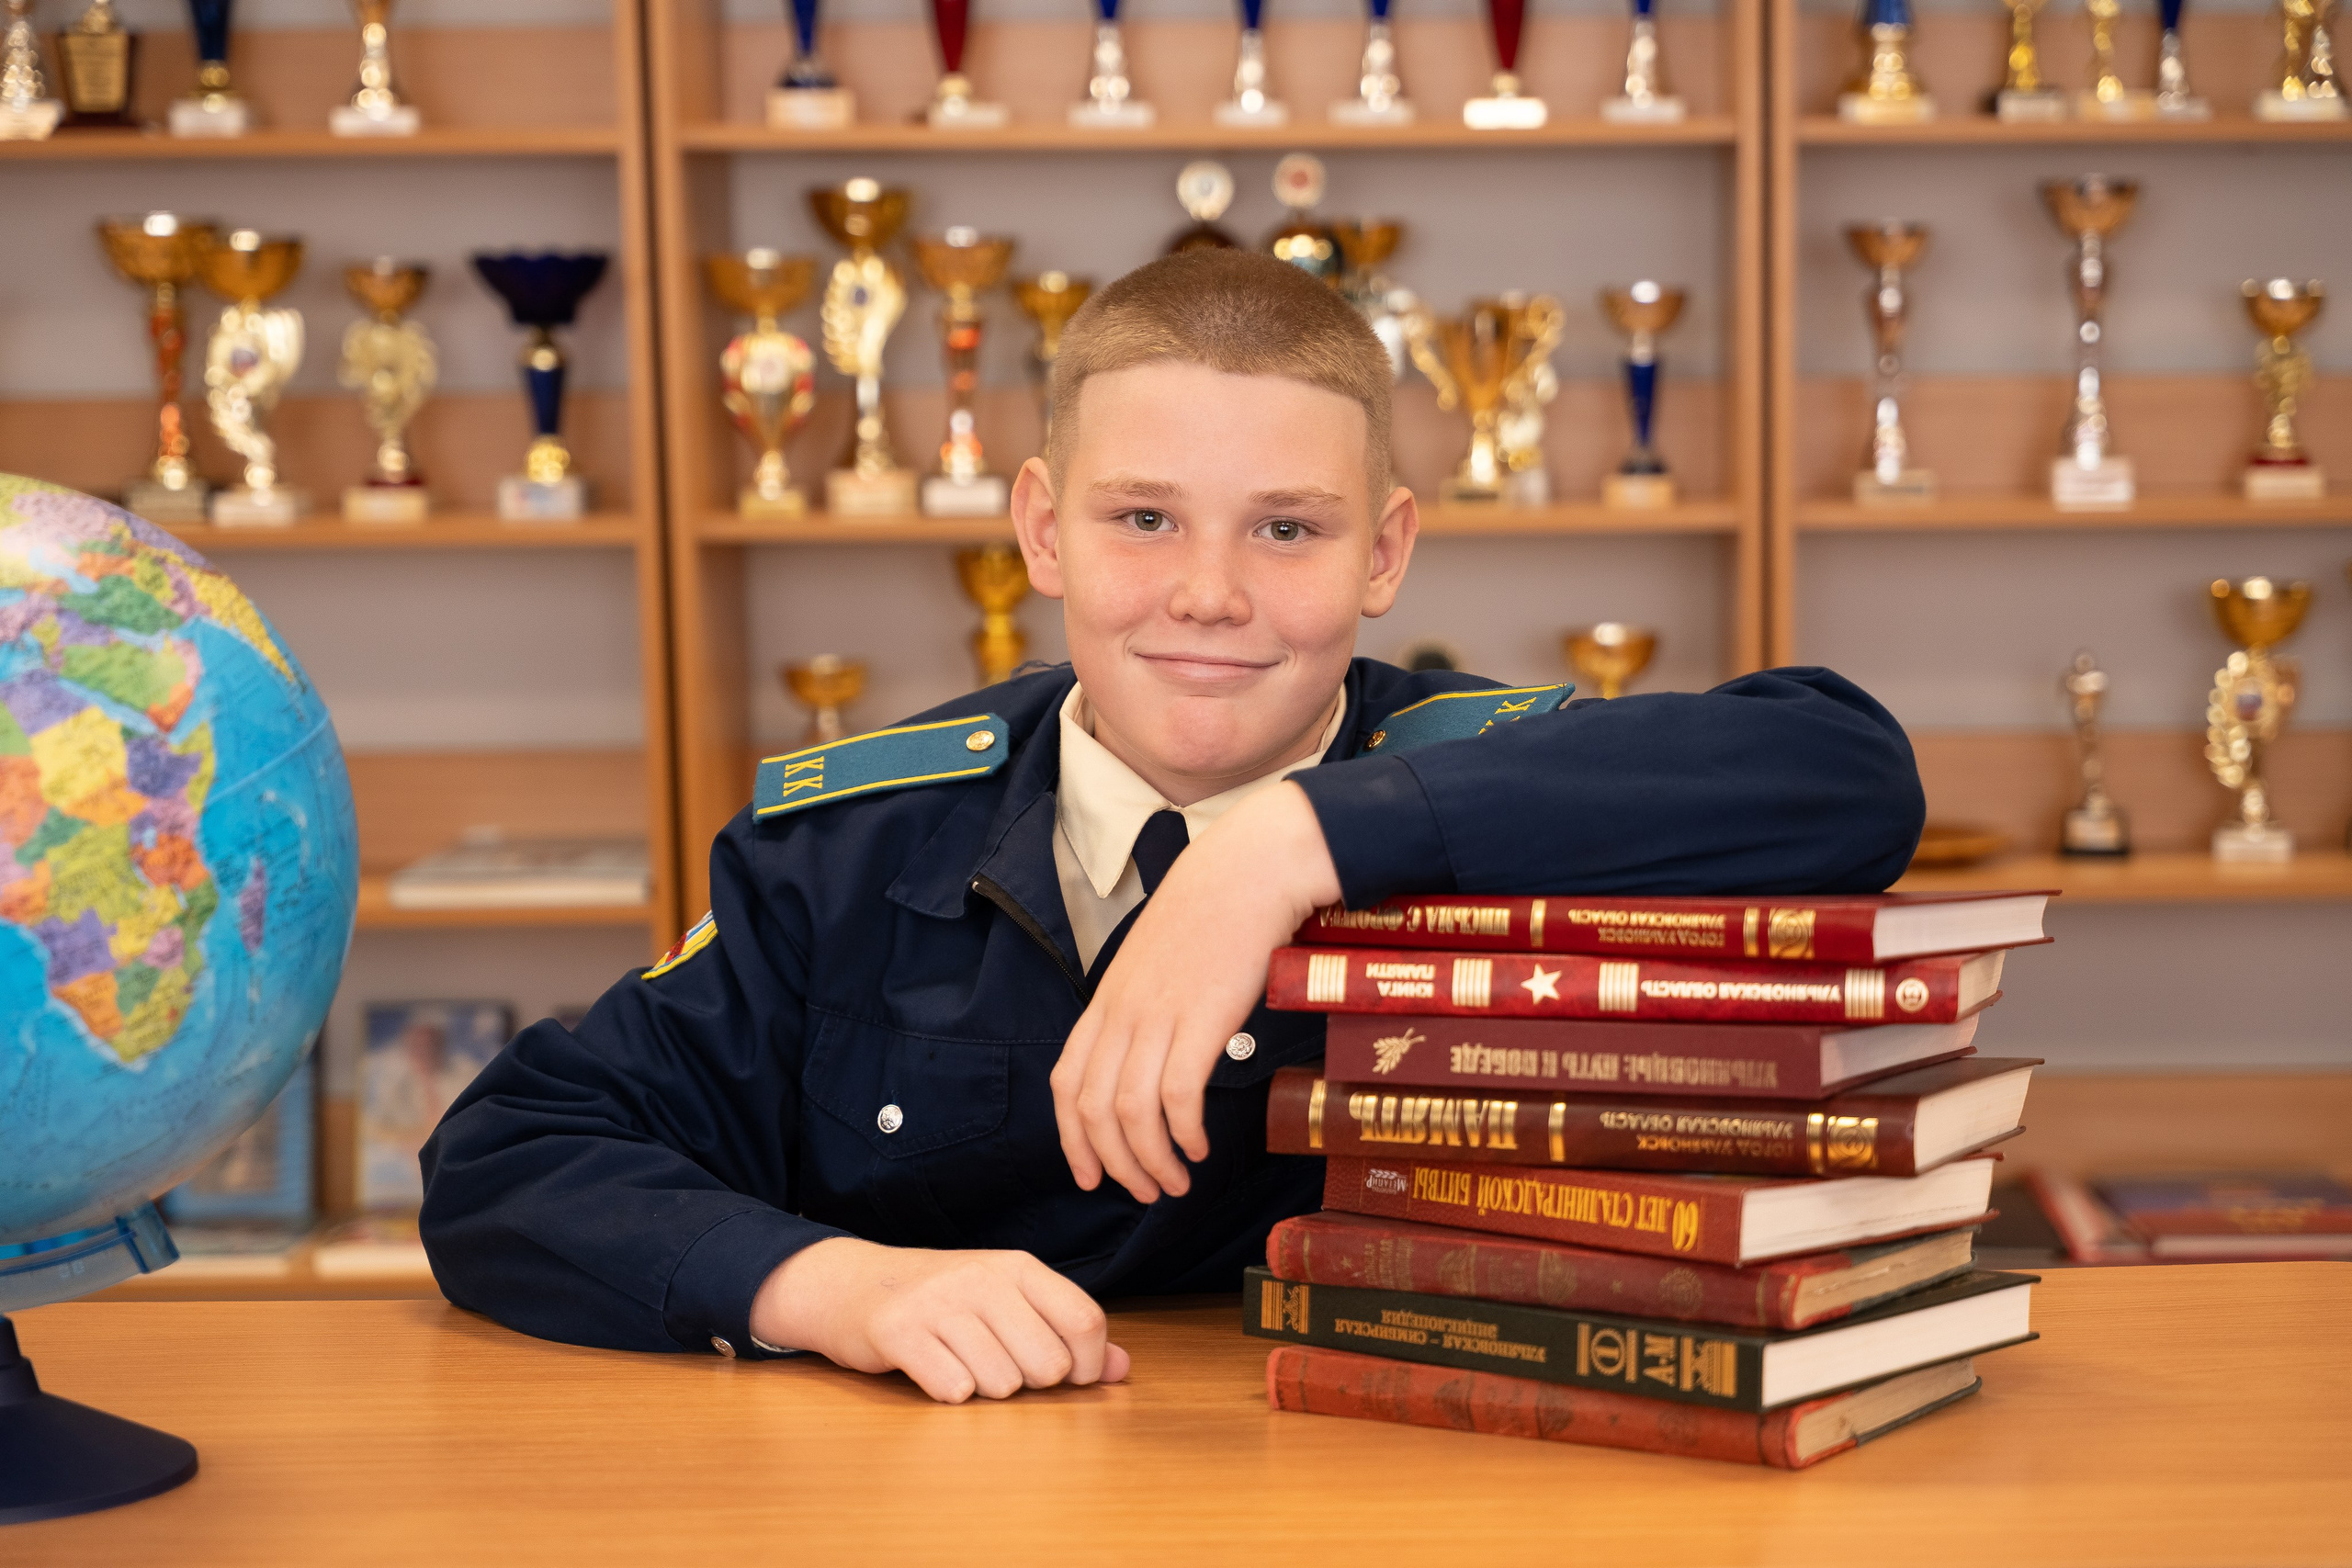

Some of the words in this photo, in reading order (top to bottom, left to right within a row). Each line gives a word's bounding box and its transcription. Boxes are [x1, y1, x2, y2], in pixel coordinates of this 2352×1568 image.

[783, 755, 825, 797] КК
[1406, 904, 1420, 931] С
[1424, 904, 1509, 935] ПИСЬМА
[1567, 908, 1628, 924] ОБЛАСТЬ
[1629, 910, 1724, 928] УЛЬЯНОВСКАЯ
[1597, 926, 1676, 944] УЛЬЯНОВСК
[1676, 928, 1724, 946] ГОРОД
[1365, 962, 1434, 979] ПАМЯТИ
[1376, 979, 1433, 997] КНИГА
[1640, 979, 1716, 998] ОБЛАСТЬ
[1718, 982, 1839, 1001] УЛЬЯНОВСКАЯ
[1449, 1041, 1536, 1075] ПОБЕДЕ
[1541, 1049, 1556, 1077] К
[1561, 1051, 1619, 1080] ПУТЬ
[1623, 1051, 1776, 1087] УЛЬЯНОВЦЫ:
[1348, 1091, 1517, 1148] ПАМЯТЬ
[1599, 1111, 1672, 1132] ОБЛАСТЬ
[1676, 1115, 1792, 1137] УЛЬЯНОВСКАЯ
[1635, 1134, 1731, 1152] УЛЬЯНОВСК
[1736, 1138, 1792, 1155] ГОРОД
[1411, 1166, 1470, 1205] БИТВЫ
[1476, 1174, 1633, 1225] СТАЛИНГРАДСКОЙ
[1634, 1193, 1670, 1231] ЛЕТ
[1670, 1199, 1698, 1251] 60
[1333, 1317, 1427, 1343] СИМБИРСКАЯ
[1380, 1308, 1497, 1337] ЭНЦИКЛОПЕДИЯ
[1442, 1332, 1545, 1361] УЛЬЯНОВСКАЯ
